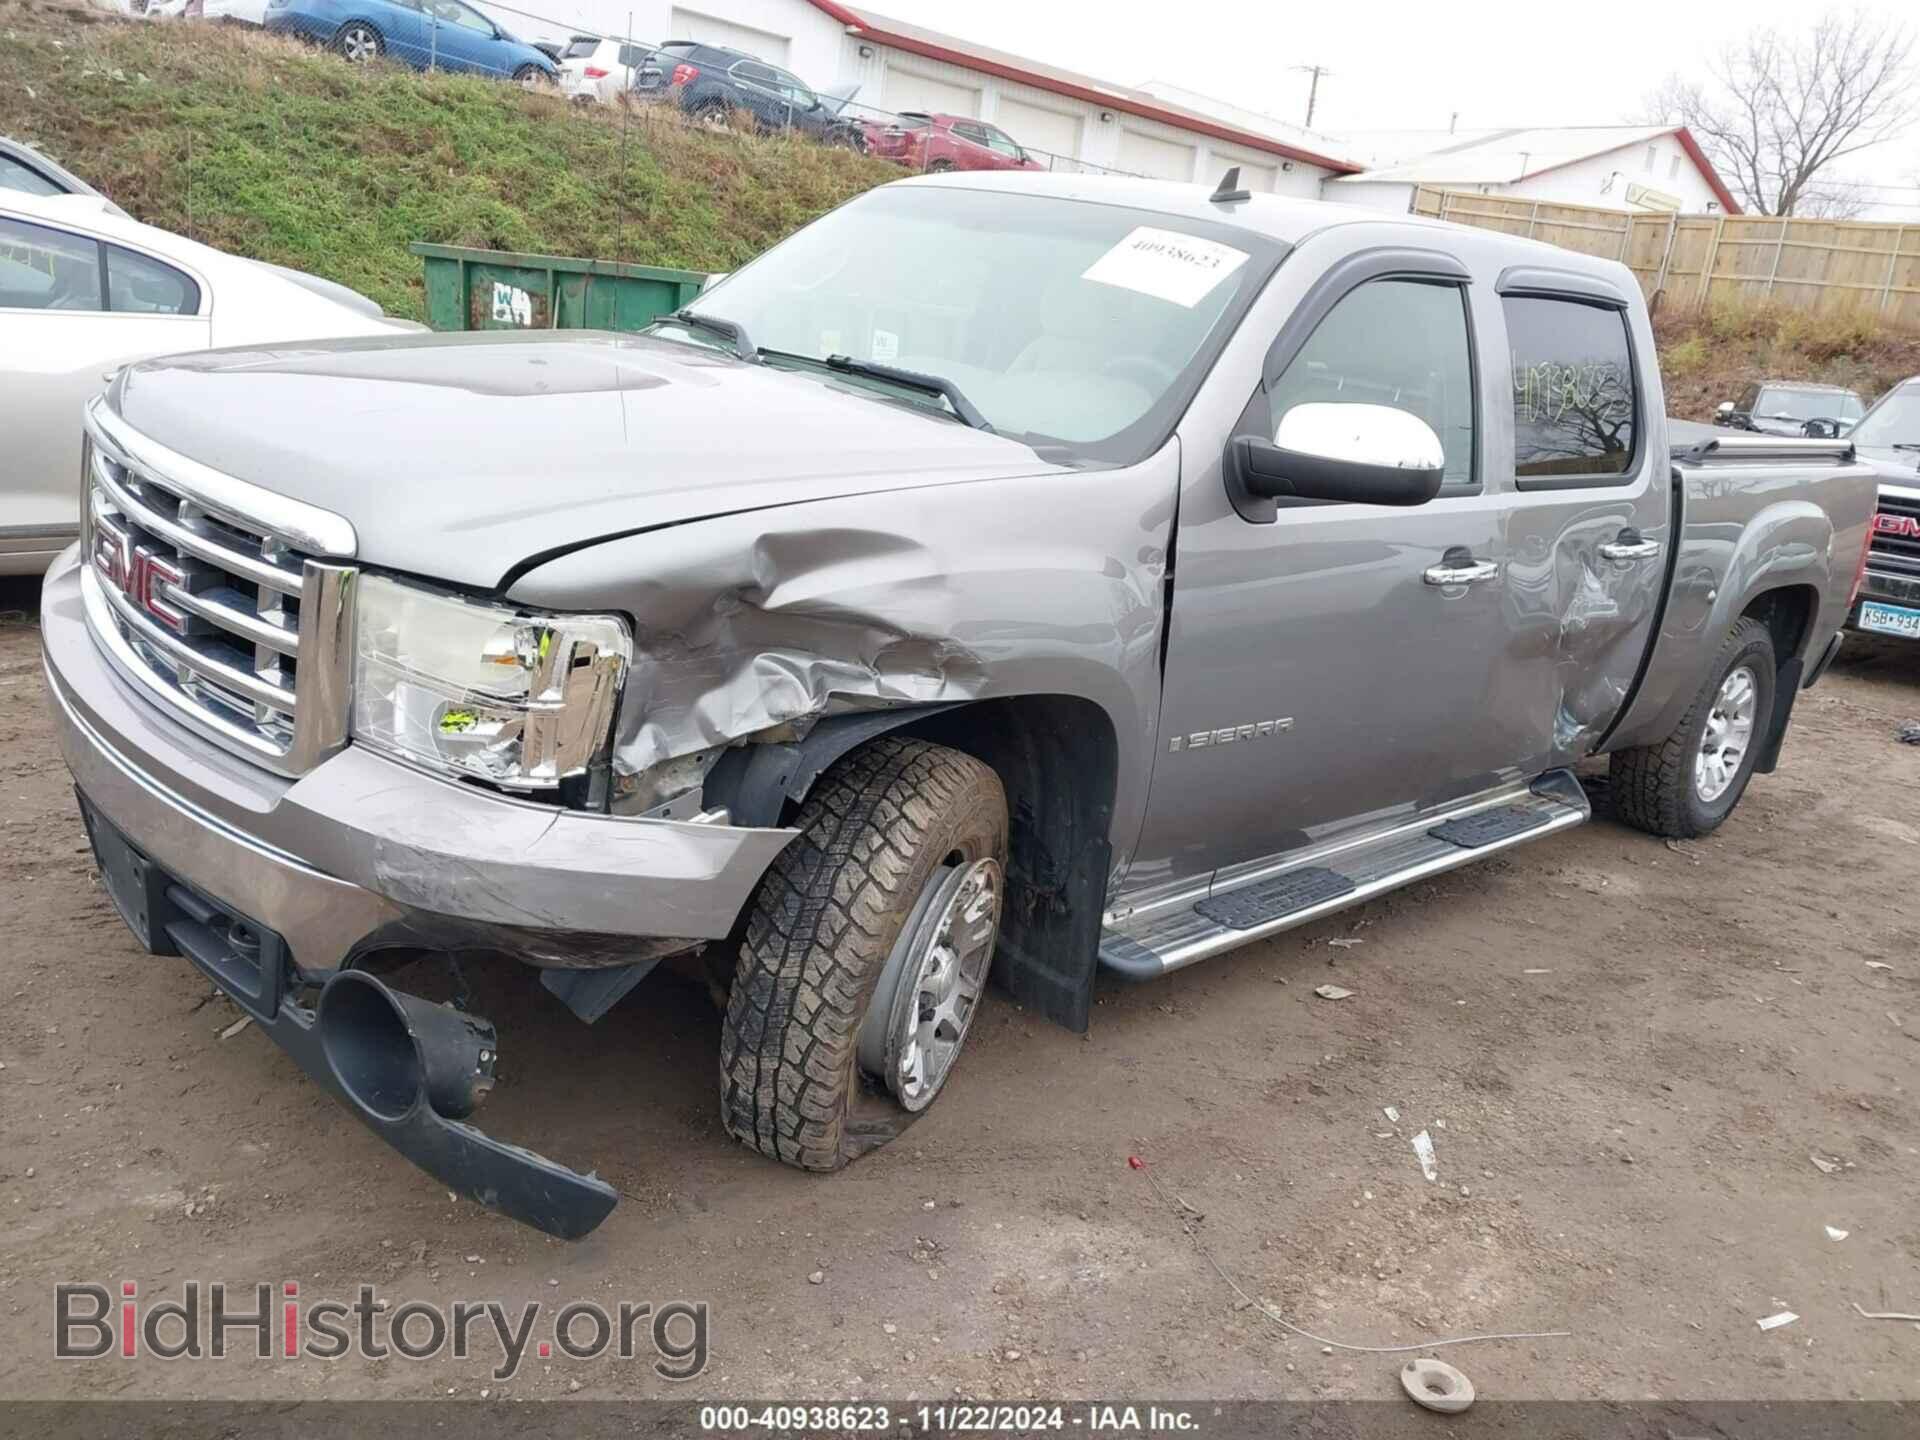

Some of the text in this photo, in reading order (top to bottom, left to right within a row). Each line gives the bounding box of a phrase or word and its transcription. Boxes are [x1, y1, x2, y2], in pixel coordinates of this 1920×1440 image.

[1872, 512, 1920, 538] GM
[94, 517, 188, 636] GMC
[1864, 608, 1889, 625] KSB
[1897, 614, 1919, 630] 934
[1187, 716, 1295, 749] SIERRA
